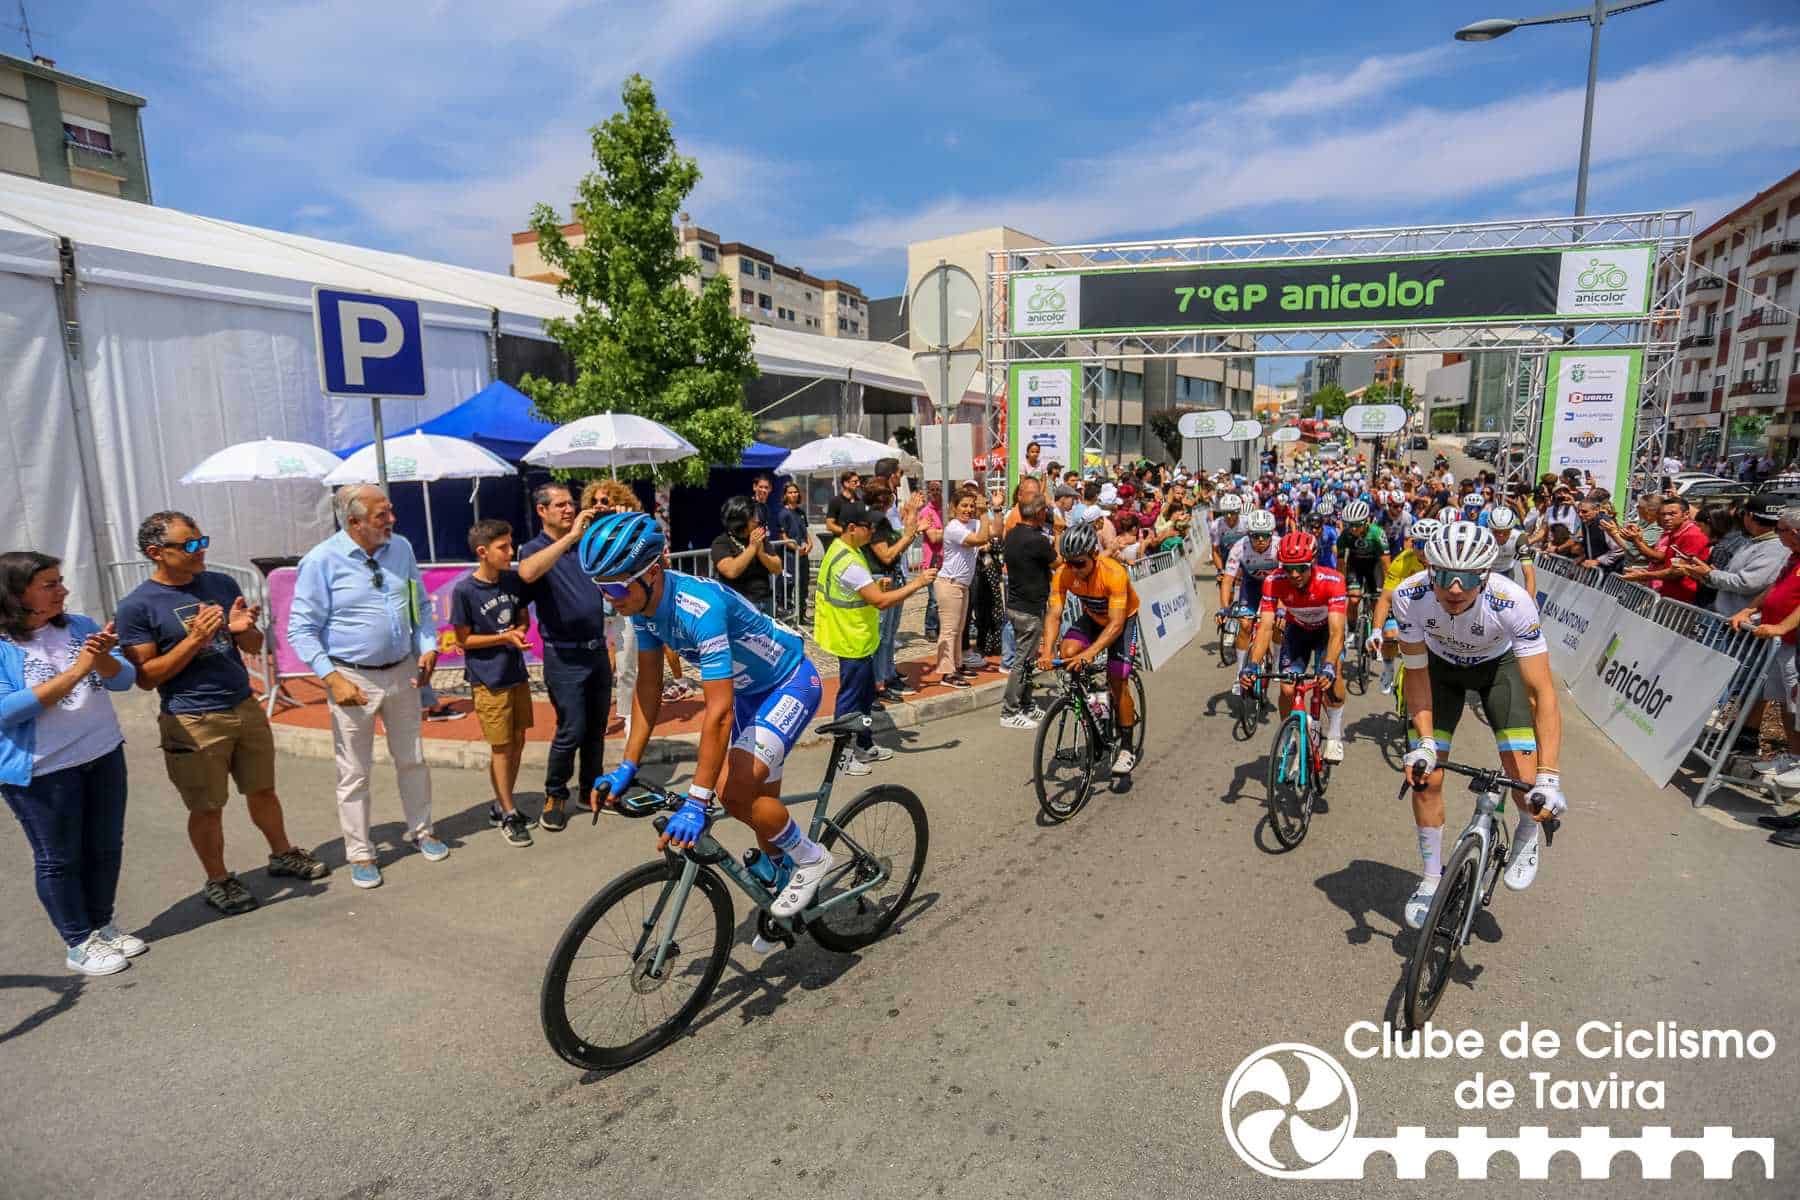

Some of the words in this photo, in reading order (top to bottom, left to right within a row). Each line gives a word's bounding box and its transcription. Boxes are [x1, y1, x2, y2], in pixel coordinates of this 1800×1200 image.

[1280, 272, 1444, 311] anicolor
[1576, 292, 1626, 303] anicolor
[1026, 313, 1065, 322] anicolor
[338, 300, 404, 385] P
[1543, 600, 1560, 620] SAN
[1605, 660, 1673, 719] anicolor
